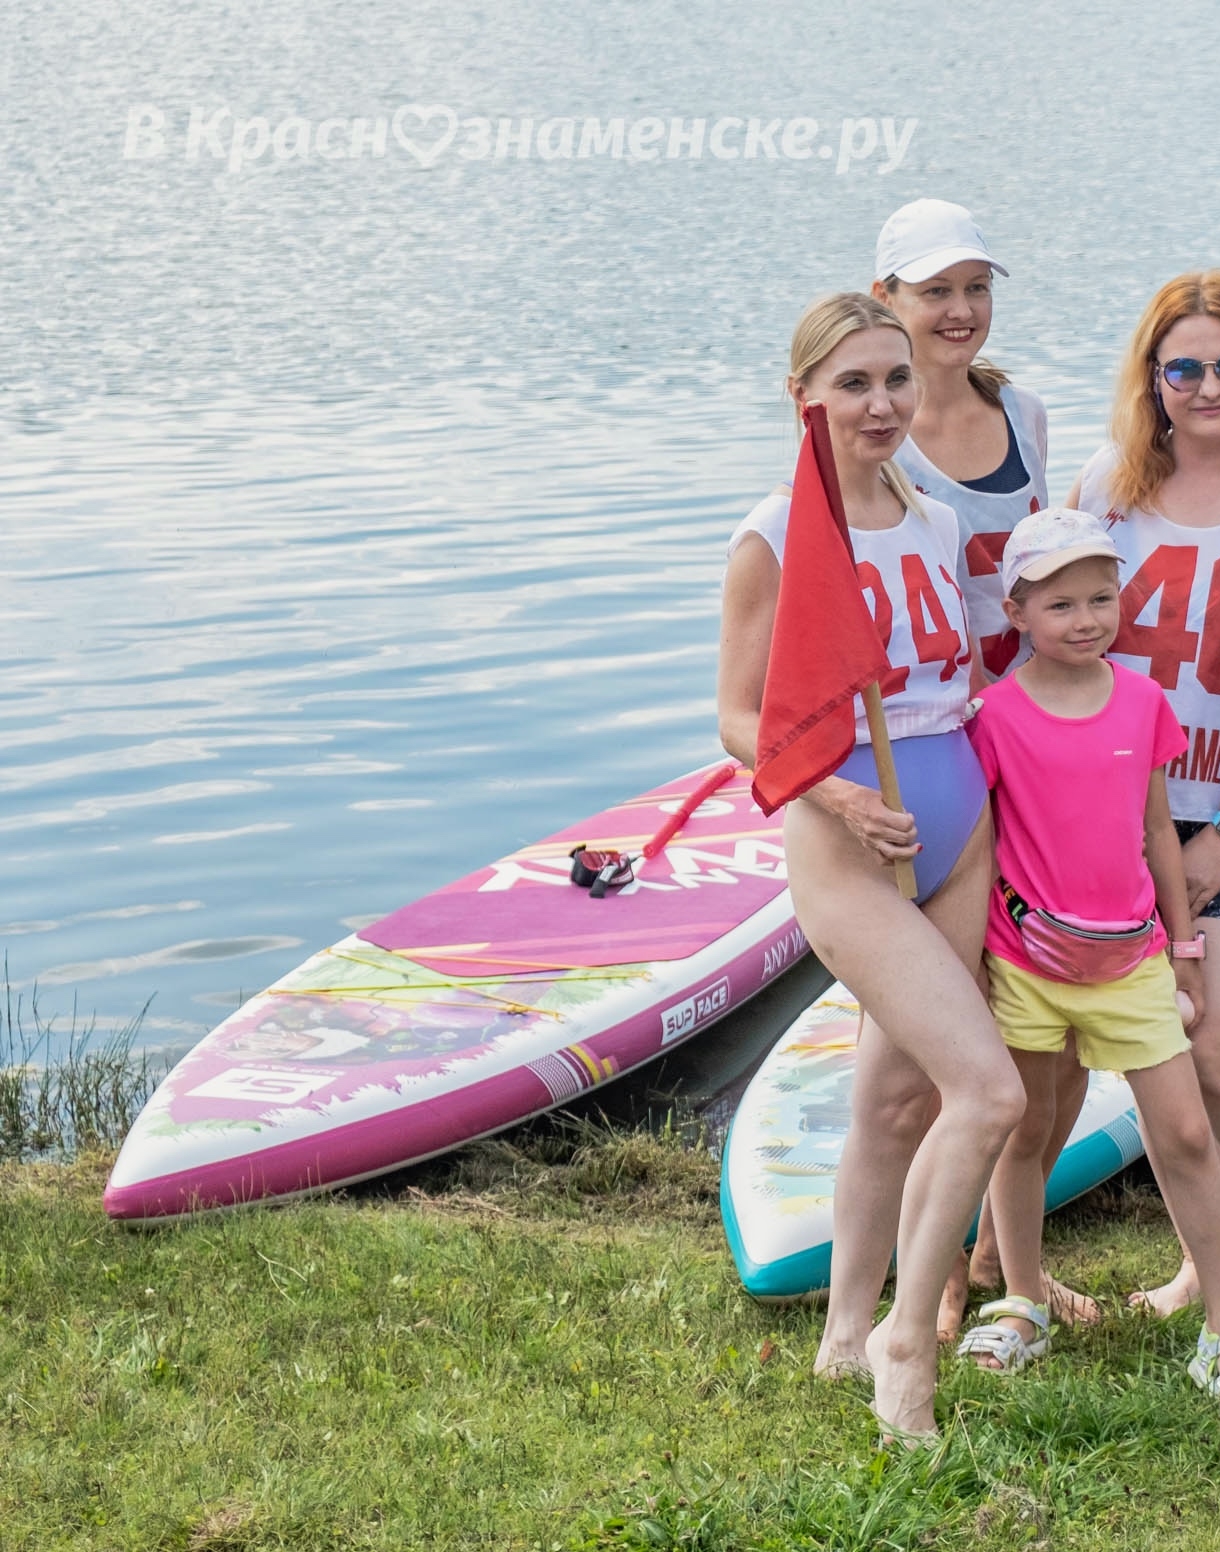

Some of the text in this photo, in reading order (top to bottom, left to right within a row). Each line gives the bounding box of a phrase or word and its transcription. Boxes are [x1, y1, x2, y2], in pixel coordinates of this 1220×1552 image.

[761, 935, 789, 981] ANY
[666, 985, 728, 1036] SUP FACE
